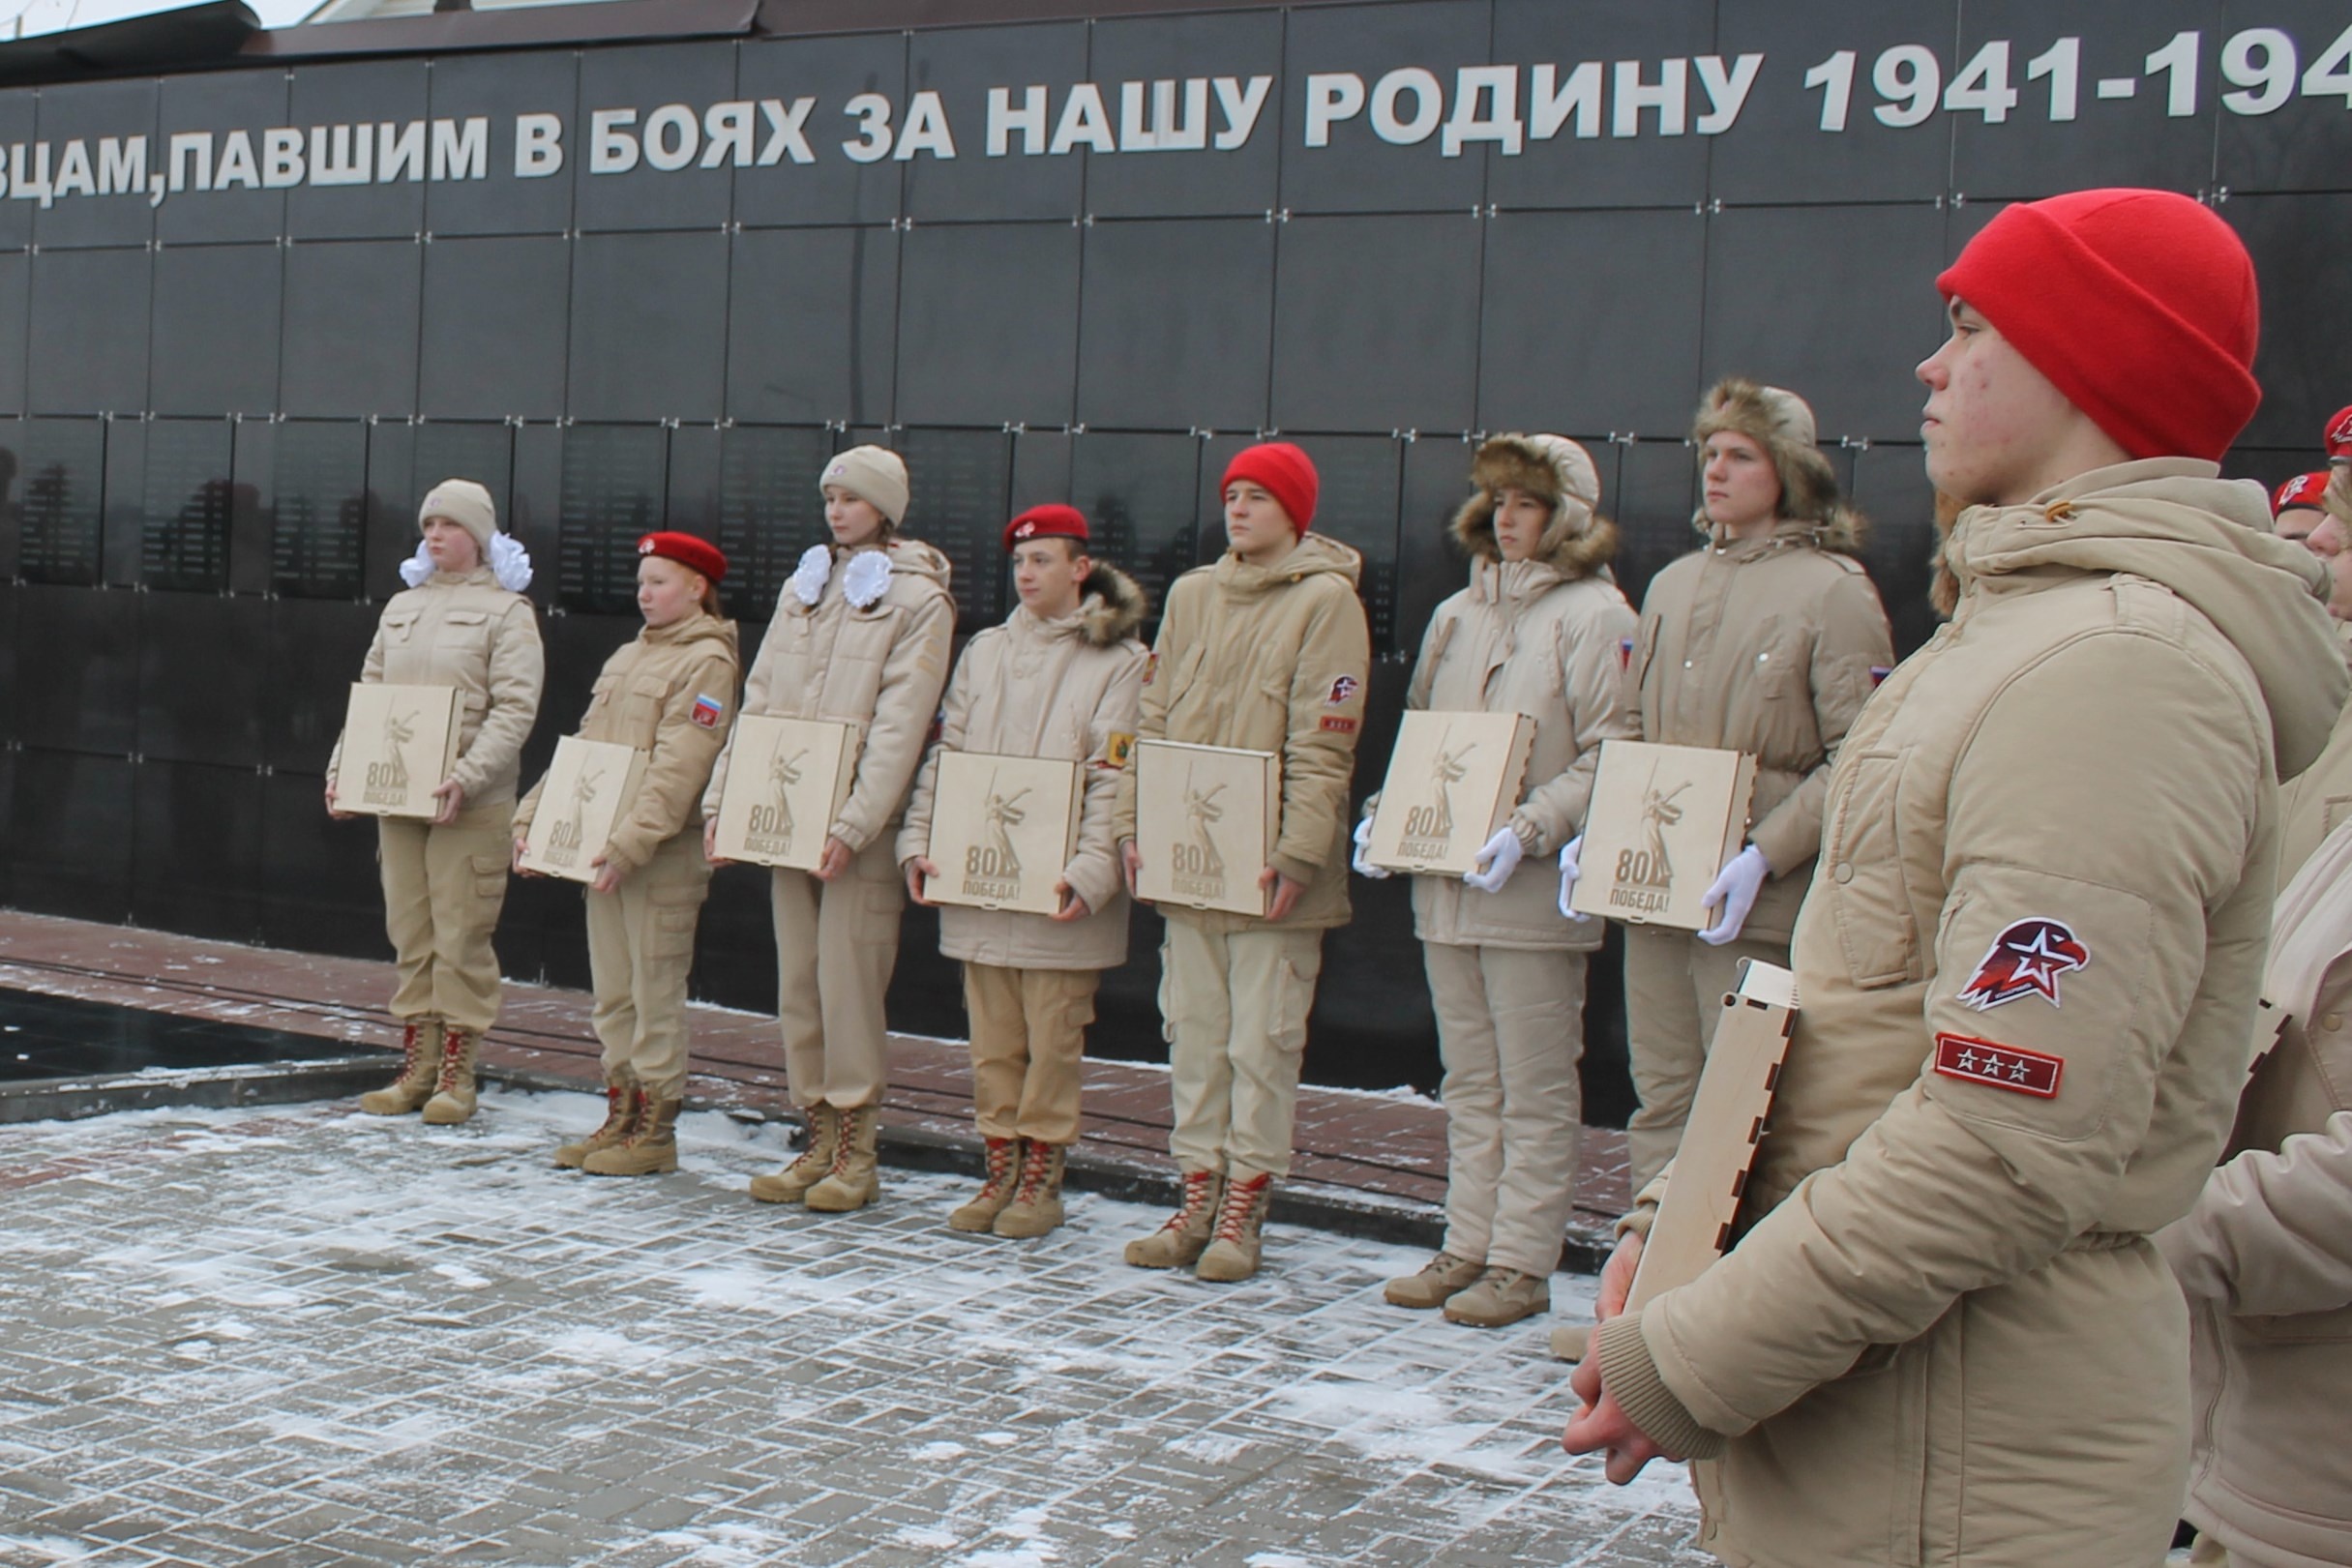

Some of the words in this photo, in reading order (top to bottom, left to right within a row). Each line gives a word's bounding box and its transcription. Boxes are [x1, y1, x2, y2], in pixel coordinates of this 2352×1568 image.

[0, 117, 489, 209] ЦАМ,ПАВШИМ
[515, 113, 563, 178] В
[590, 97, 816, 174] БОЯХ
[842, 91, 957, 163] ЗА
[986, 75, 1273, 157] НАШУ
[1304, 53, 1765, 157] РОДИНУ
[367, 761, 391, 787] 80
[550, 819, 572, 847] 80
[748, 804, 776, 833] 80
[1405, 806, 1434, 835] 80
[966, 845, 997, 876] 80
[1172, 843, 1201, 874] 80
[1396, 842, 1448, 860] ПОБЕДА!
[1616, 848, 1650, 884] 80
[962, 880, 1021, 902] ПОБЕДА!
[1609, 888, 1670, 913] ПОБЕДА!
